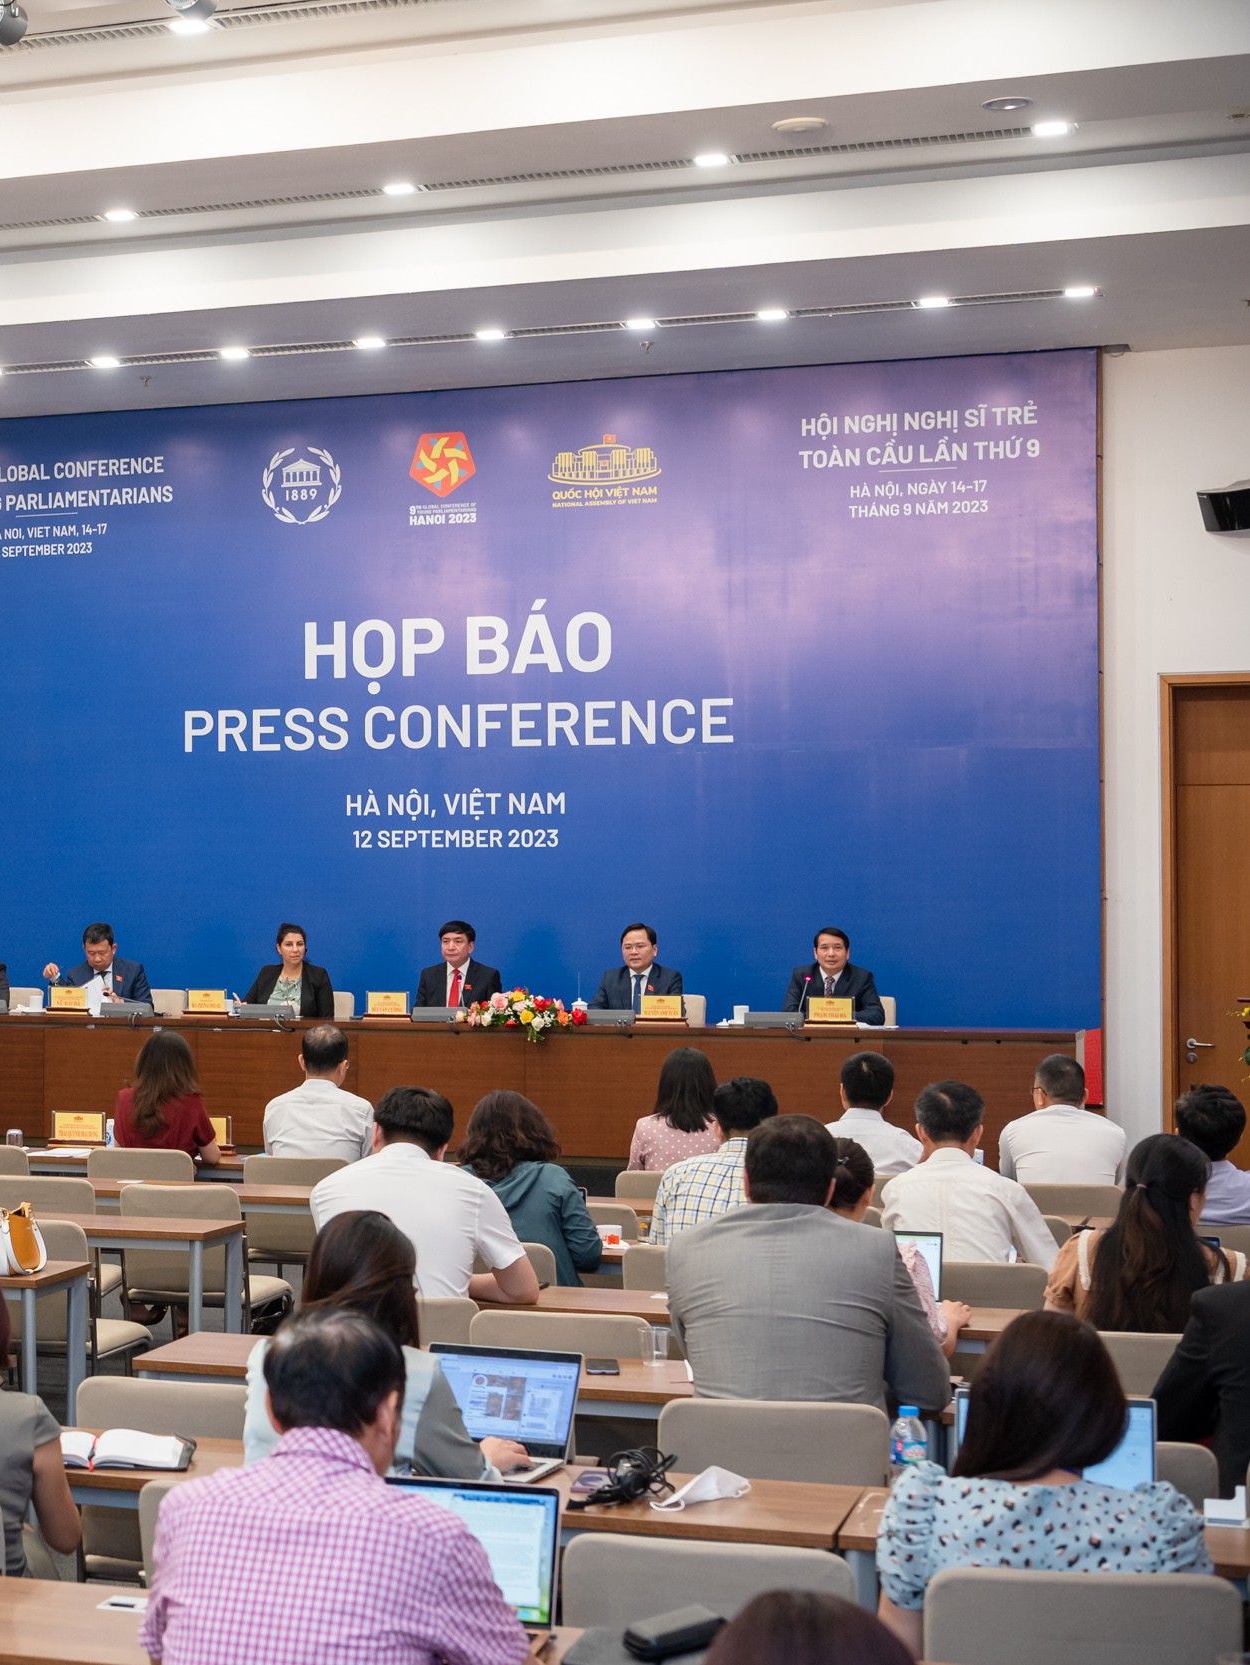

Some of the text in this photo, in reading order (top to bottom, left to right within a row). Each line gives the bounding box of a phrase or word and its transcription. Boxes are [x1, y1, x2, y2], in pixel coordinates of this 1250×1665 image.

[801, 400, 1038, 440] HỘI NGHỊ NGHỊ SĨ TRẺ
[799, 436, 1040, 469] TOÀN CẦU LẦN THỨ 9
[53, 456, 164, 480] CONFERENCE
[6, 485, 173, 511] PARLIAMENTARIANS
[285, 488, 317, 501] 1889
[552, 485, 658, 500] QUỐC HỘI VIỆT NAM
[850, 479, 987, 500] HÀ NỘI, NGÀY 14-17
[584, 499, 616, 507] ASSEMBLY
[849, 499, 989, 518] THÁNG 9 NĂM 2023
[409, 512, 477, 526] HANOI 2023
[4, 527, 25, 541] NOI,
[27, 526, 51, 539] VIET
[53, 525, 79, 538] NAM,
[81, 523, 108, 536] 14-17
[1, 541, 93, 558] SEPTEMBER 2023
[304, 598, 612, 695] HỌP BÁO
[184, 697, 734, 753] PRESS CONFERENCE
[346, 788, 566, 821] HÀ NỘI, VIỆT NAM
[352, 828, 559, 849] 12 SEPTEMBER 2023
